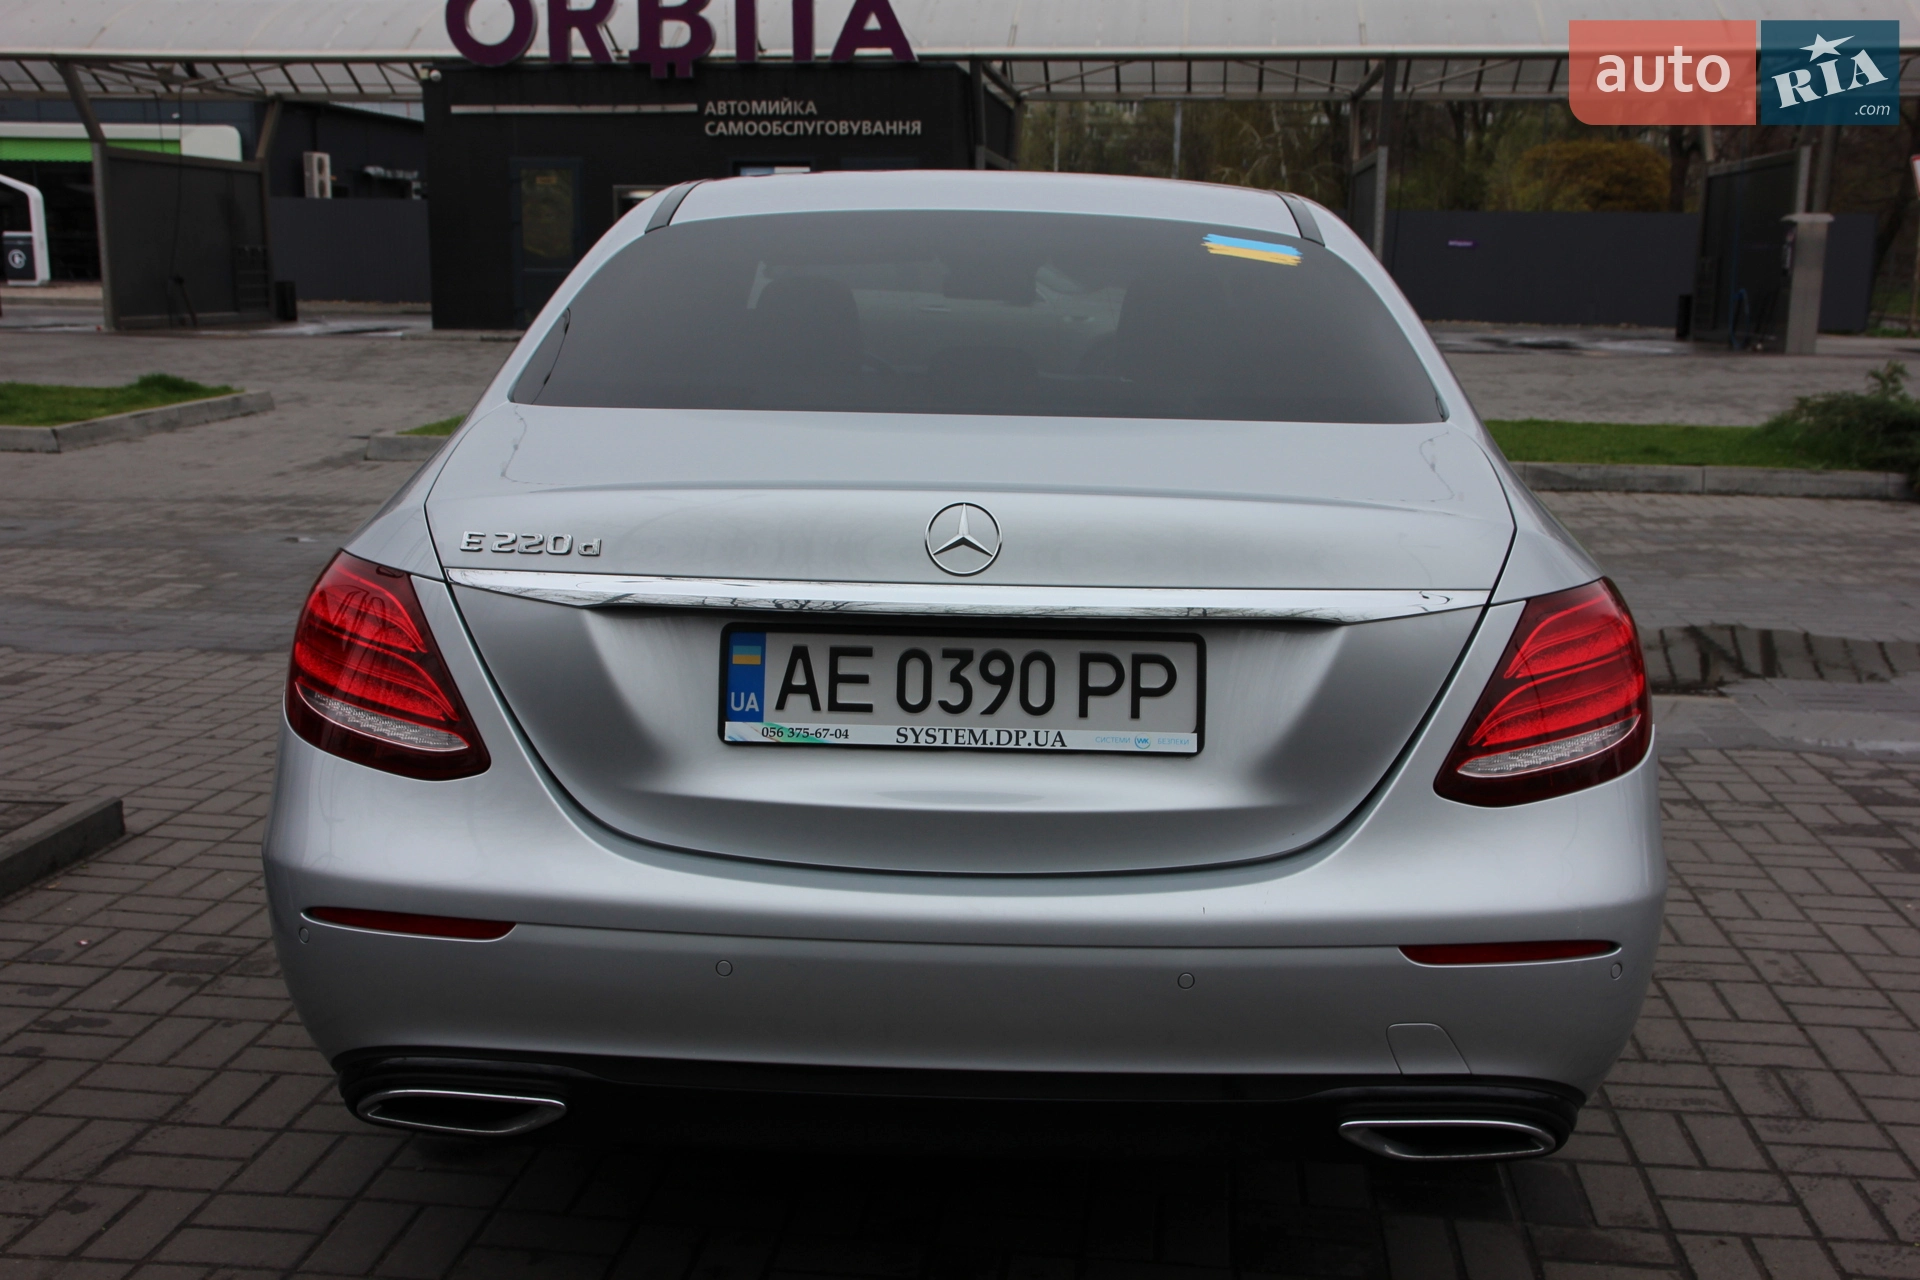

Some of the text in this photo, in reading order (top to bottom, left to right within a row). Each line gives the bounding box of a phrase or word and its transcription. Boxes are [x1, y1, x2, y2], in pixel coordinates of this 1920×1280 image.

[704, 98, 818, 115] АВТОМИЙКА
[704, 120, 922, 136] САМООБСЛУГОВУВАННЯ
[460, 531, 486, 552] E
[775, 645, 1178, 719] AE 0390 PP
[731, 692, 760, 712] UA
[761, 727, 849, 739] 056 375-67-04
[895, 727, 1067, 748] SYSTEM.DP.UA
[1095, 736, 1131, 744] СИСТЕМИ
